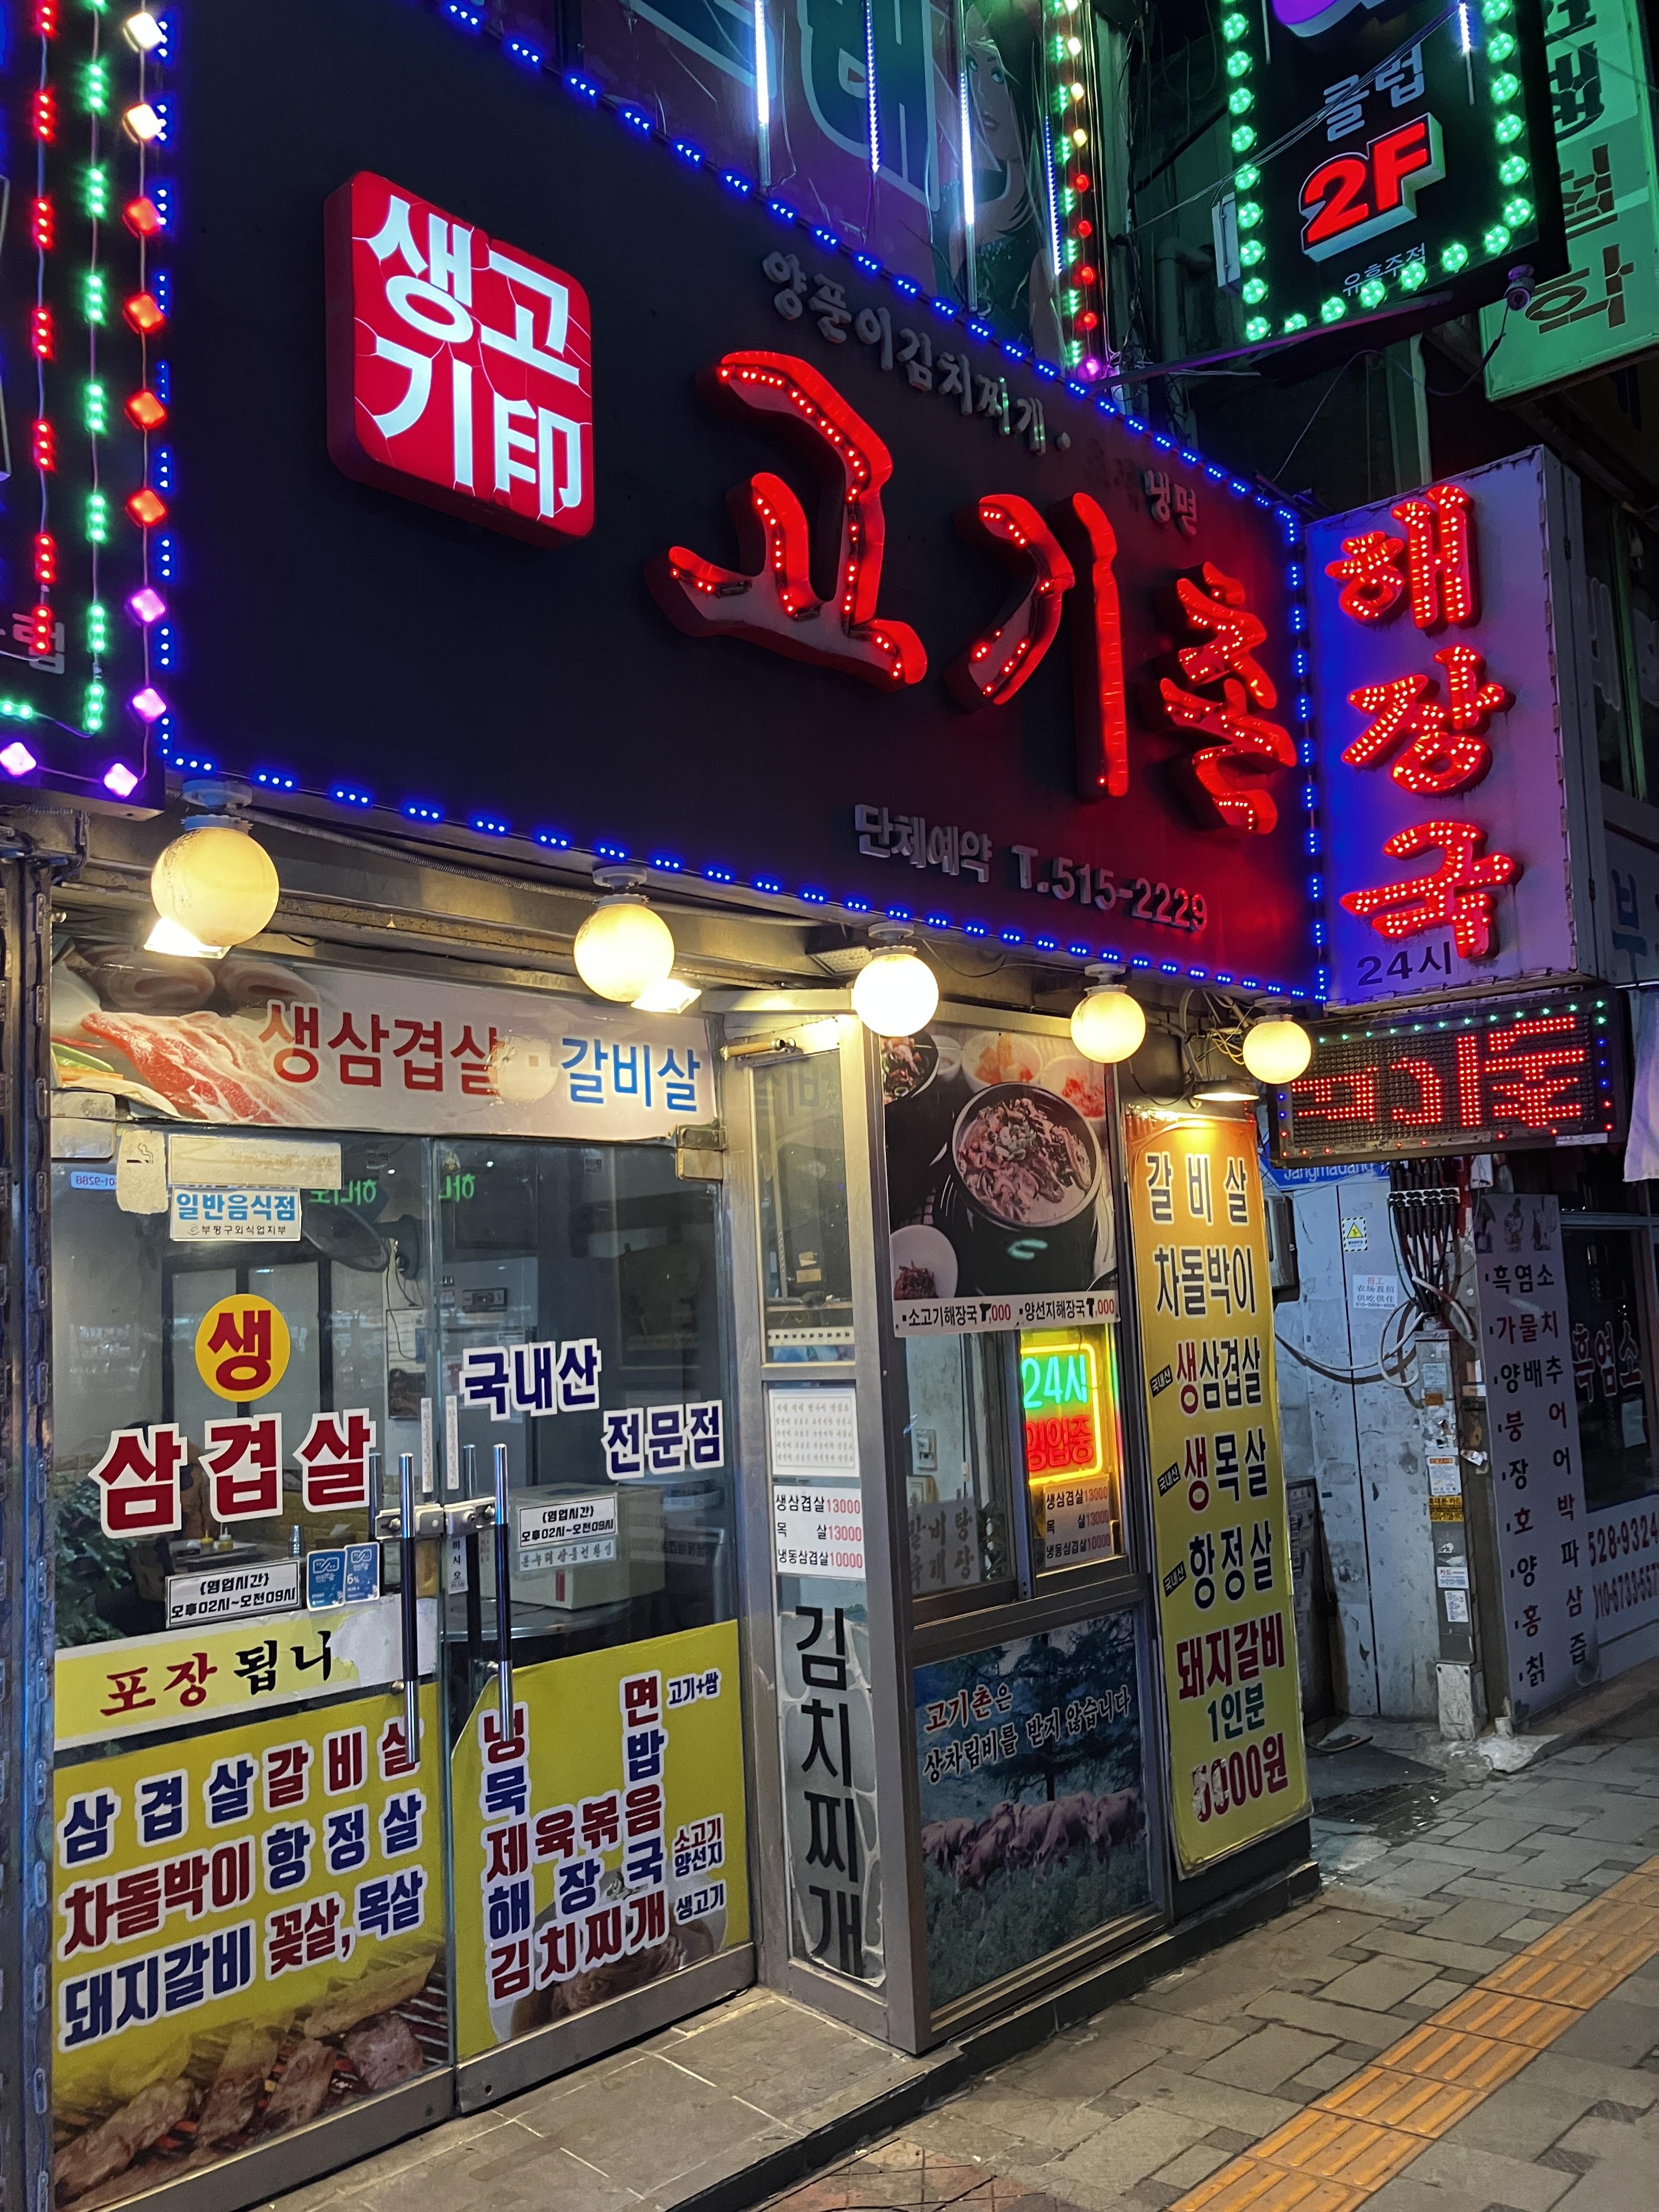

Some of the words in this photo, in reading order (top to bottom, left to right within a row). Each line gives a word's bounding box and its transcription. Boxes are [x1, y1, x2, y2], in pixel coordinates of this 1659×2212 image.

[1323, 42, 1425, 142] 클럽
[1301, 119, 1428, 245] 2F
[1342, 242, 1426, 297] 유흥주점
[1143, 469, 1198, 538] 냉면
[665, 351, 1297, 835] 고기촌
[1324, 485, 1516, 959] 해장국
[855, 803, 992, 883] 단체예약
[1011, 844, 1207, 932] T.515-2229
[1357, 940, 1452, 986] 24시
[258, 997, 504, 1097] 생삼겹살
[560, 1035, 702, 1114] 갈비살
[176, 1193, 295, 1221] 일반음식점
[1146, 1153, 1248, 1224] 갈비살
[202, 1225, 286, 1235] 부평구외식업지부
[909, 1305, 978, 1327] 소고기해장국
[1024, 1300, 1086, 1321] 양선지해장국
[1154, 1246, 1256, 1317] 차돌박이
[1492, 1263, 1554, 1294] 흑염소
[207, 1309, 272, 1391] 생
[1497, 1310, 1559, 1344] 가물치
[1572, 1320, 1642, 1402] 흑염소
[465, 1344, 597, 1415] 국내산
[1021, 1354, 1087, 1409] 24시
[1151, 1365, 1172, 1397] 국내산
[1177, 1338, 1261, 1414] 생삼겹살
[1500, 1356, 1564, 1393] 양배추
[99, 1415, 371, 1531] 삼겹살
[607, 1405, 720, 1474] 전문점
[1184, 1427, 1268, 1511] 생목살
[542, 1505, 594, 1523] (영업시간)
[776, 1495, 825, 1513] 생삼겹살
[826, 1498, 860, 1515] 13000
[1047, 1489, 1084, 1509] 생삼겹살
[1158, 1463, 1181, 1497] 국내산
[778, 1548, 828, 1566] 냉동삼겹살
[830, 1553, 864, 1568] 10000
[828, 1526, 862, 1542] 13000
[1189, 1520, 1272, 1610] 항정살
[1164, 1562, 1186, 1595] 국내산
[669, 1671, 720, 1707] 고기+쌈
[1177, 1613, 1285, 1701] 돼지갈비
[924, 1723, 1018, 1784] 상차림비를
[1026, 1707, 1061, 1748] 받지
[1066, 1684, 1131, 1734] 않습니다
[925, 1684, 1013, 1731] 고기촌은
[1207, 1682, 1265, 1743] 1인분
[64, 1760, 255, 1865] 삼겹살
[267, 1723, 421, 1809] 갈비살
[795, 1605, 864, 1979] 김치찌개
[486, 1784, 663, 1882] 제육볶음
[674, 1816, 723, 1851] 소고기
[675, 1841, 723, 1877] 양선지
[64, 1841, 250, 1956] 차돌박이
[267, 1794, 422, 1891] 항정살
[489, 1837, 664, 1940] 해장국
[64, 1925, 251, 2047] 돼지갈비
[269, 1897, 351, 1976] 꽃살,
[359, 1870, 423, 1935] 목살
[490, 1889, 666, 2000] 김치찌개
[676, 1886, 725, 1921] 생고기
